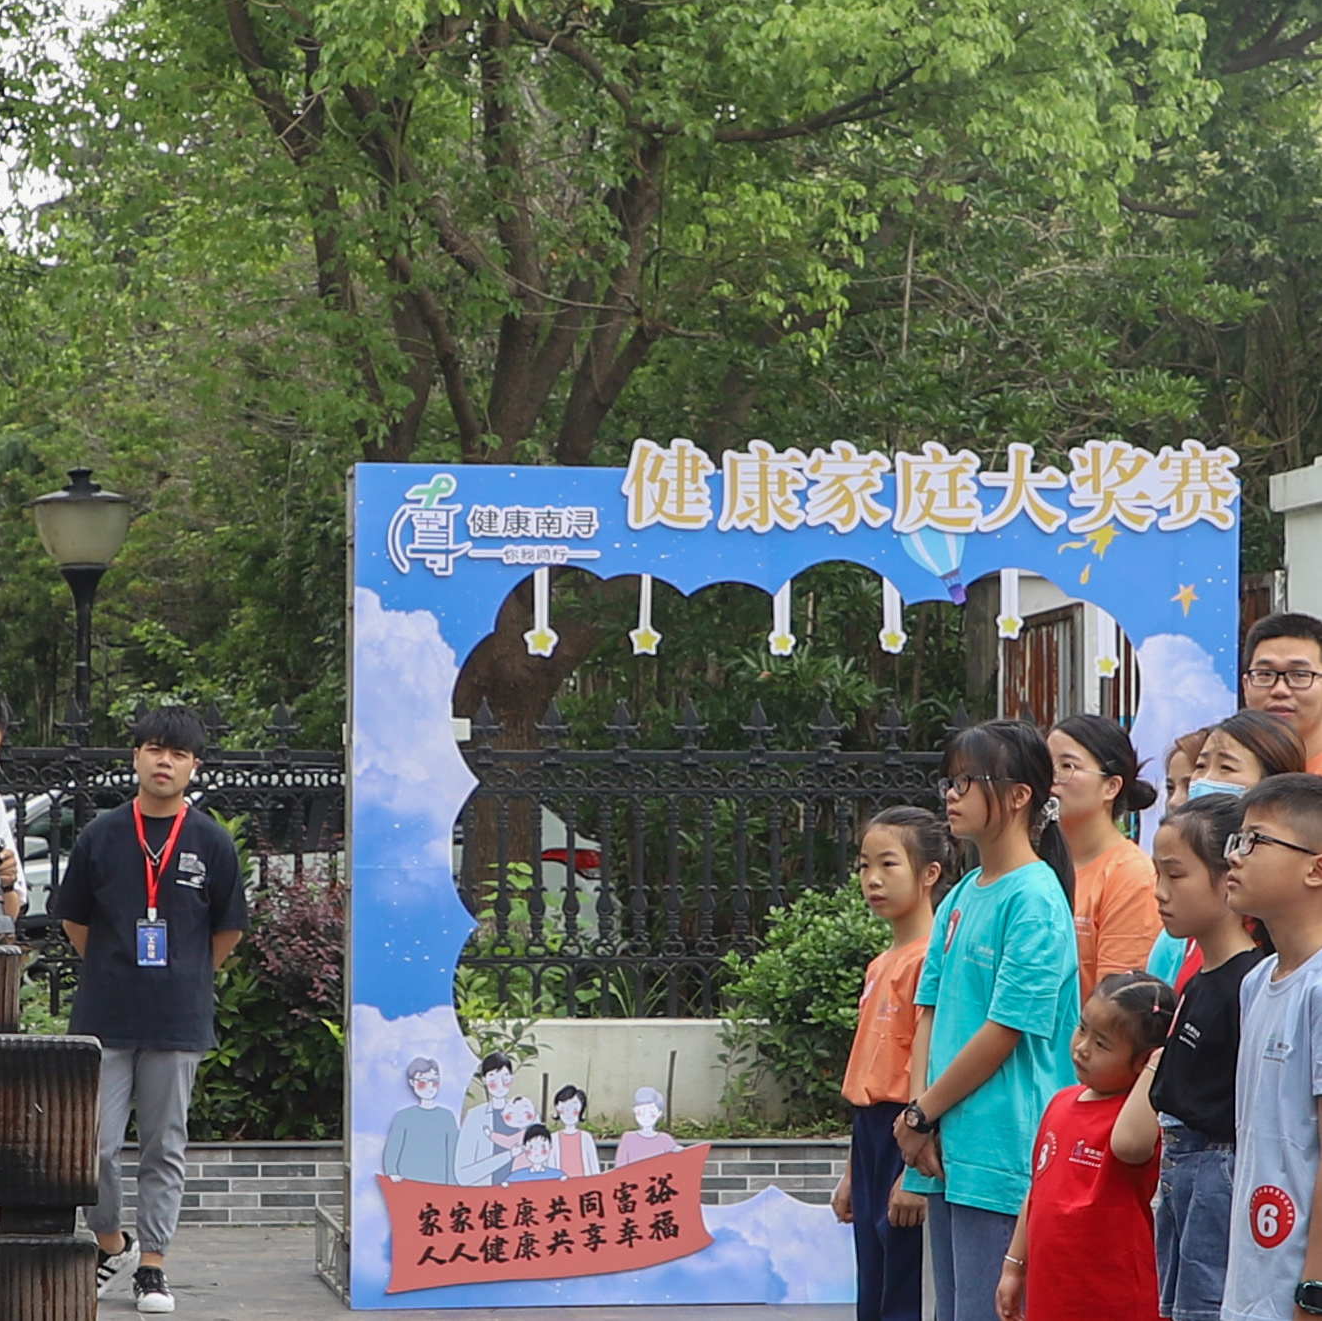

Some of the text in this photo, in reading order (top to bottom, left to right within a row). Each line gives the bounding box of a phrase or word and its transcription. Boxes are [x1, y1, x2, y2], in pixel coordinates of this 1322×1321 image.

[624, 439, 1240, 533] 健康家庭大奖赛
[468, 506, 598, 537] 健康南浔
[504, 546, 568, 563] 你我同行
[417, 1172, 680, 1237] 家家健康共同富裕
[1257, 1203, 1279, 1238] 6
[417, 1209, 681, 1267] 人人健康共享幸福
